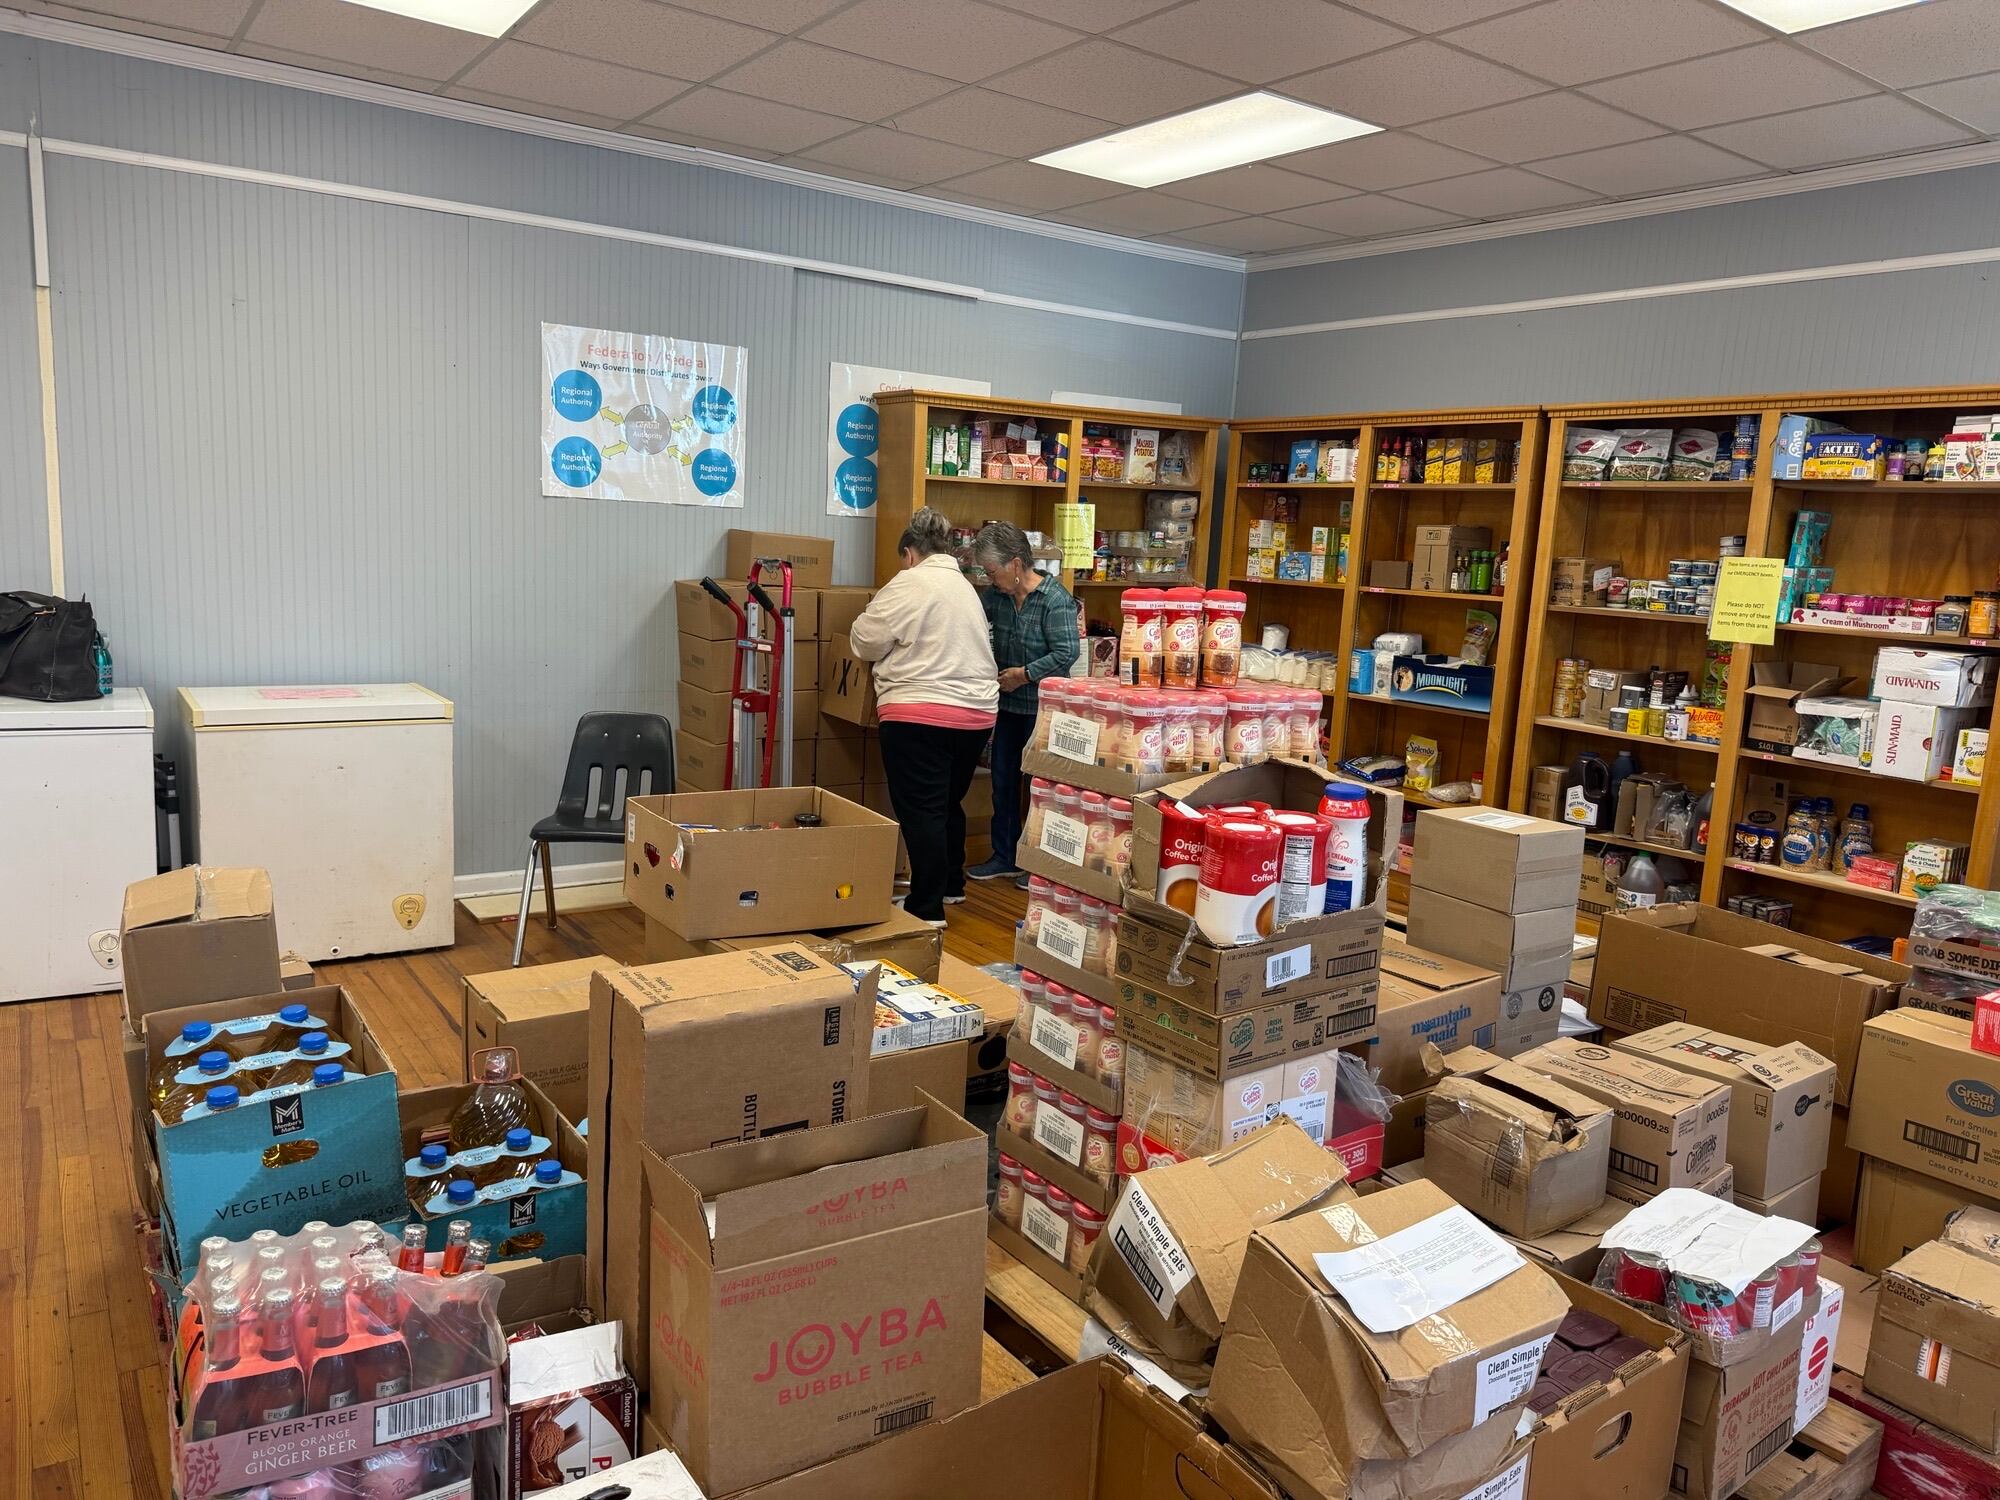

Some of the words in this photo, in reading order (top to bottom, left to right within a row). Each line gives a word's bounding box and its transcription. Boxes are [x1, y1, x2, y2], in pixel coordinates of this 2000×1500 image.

[561, 386, 593, 397] Regional
[561, 398, 593, 408] Authority
[848, 421, 874, 431] Regional
[845, 432, 875, 442] Authority
[1789, 430, 1803, 457] Bluey
[561, 453, 593, 463] Regional
[1823, 446, 1841, 454] ACT
[700, 464, 728, 474] Regional
[700, 474, 728, 483] Authority
[846, 474, 873, 483] Regional
[844, 484, 874, 494] Authority
[1739, 612, 1748, 620] any
[1822, 617, 1843, 626] Cream
[1852, 620, 1890, 630] Mushroom
[1416, 672, 1466, 695] MOONLIGHT
[1687, 708, 1722, 722] Velveeta
[1406, 741, 1435, 755] Splenda
[1164, 848, 1189, 862] Coffee
[1332, 853, 1354, 865] CREAMER
[1911, 854, 1937, 863] Butternut
[1251, 872, 1273, 883] Coffee
[1914, 944, 1945, 959] GRAB
[1948, 951, 1979, 967] SOME
[1908, 996, 1938, 1011] GRAB
[1941, 1005, 1972, 1019] SOME
[828, 1007, 840, 1044] LANGERS
[1411, 1004, 1472, 1036] mountain
[1230, 1026, 1252, 1044] Coffee
[1426, 1022, 1458, 1044] maid
[1886, 1035, 1900, 1045] USED
[1102, 1045, 1120, 1056] Coffee
[1105, 1051, 1120, 1059] mate
[1300, 1073, 1317, 1089] Coffee
[1549, 1059, 1579, 1072] Store
[1593, 1071, 1621, 1086] Cool
[832, 1080, 846, 1124] STORE
[1243, 1088, 1262, 1103] Coffee
[1955, 1084, 1996, 1105] Great
[1964, 1097, 1994, 1113] Value
[274, 1119, 302, 1130] Member's
[1945, 1115, 1965, 1128] Fruit
[1968, 1121, 1998, 1138] Smiles
[1928, 1159, 1946, 1171] Case
[1947, 1166, 1963, 1177] QTY
[1977, 1174, 1985, 1184] 32
[1987, 1178, 1998, 1188] OZ
[216, 1179, 331, 1221] VEGETABLE
[339, 1170, 372, 1189] OIL
[510, 1215, 536, 1225] Member's
[819, 1208, 868, 1228] BUBBLE
[873, 1203, 896, 1218] TEA
[1131, 1189, 1150, 1219] Clean
[1147, 1216, 1170, 1250] Simple
[1167, 1247, 1187, 1273] Eats
[764, 1271, 777, 1282] OZ
[816, 1257, 837, 1271] CUPS
[721, 1296, 737, 1307] NET
[768, 1285, 781, 1296] OZ
[1886, 1283, 1926, 1308] Cartons
[753, 1297, 948, 1383] JOYBA
[1106, 1335, 1128, 1357] Date
[1488, 1358, 1509, 1376] Clean
[1512, 1346, 1540, 1365] Simple
[778, 1365, 872, 1405] BUBBLE
[882, 1350, 923, 1377] TEA
[1752, 1371, 1766, 1393] HOT
[1766, 1363, 1781, 1383] CHILI
[1781, 1349, 1800, 1370] SAUCE
[248, 1410, 359, 1445] FEVER-TREE
[252, 1442, 295, 1460] BLOOD
[300, 1429, 351, 1448] ORANGE
[245, 1450, 312, 1475] GINGER
[318, 1439, 357, 1458] BEER
